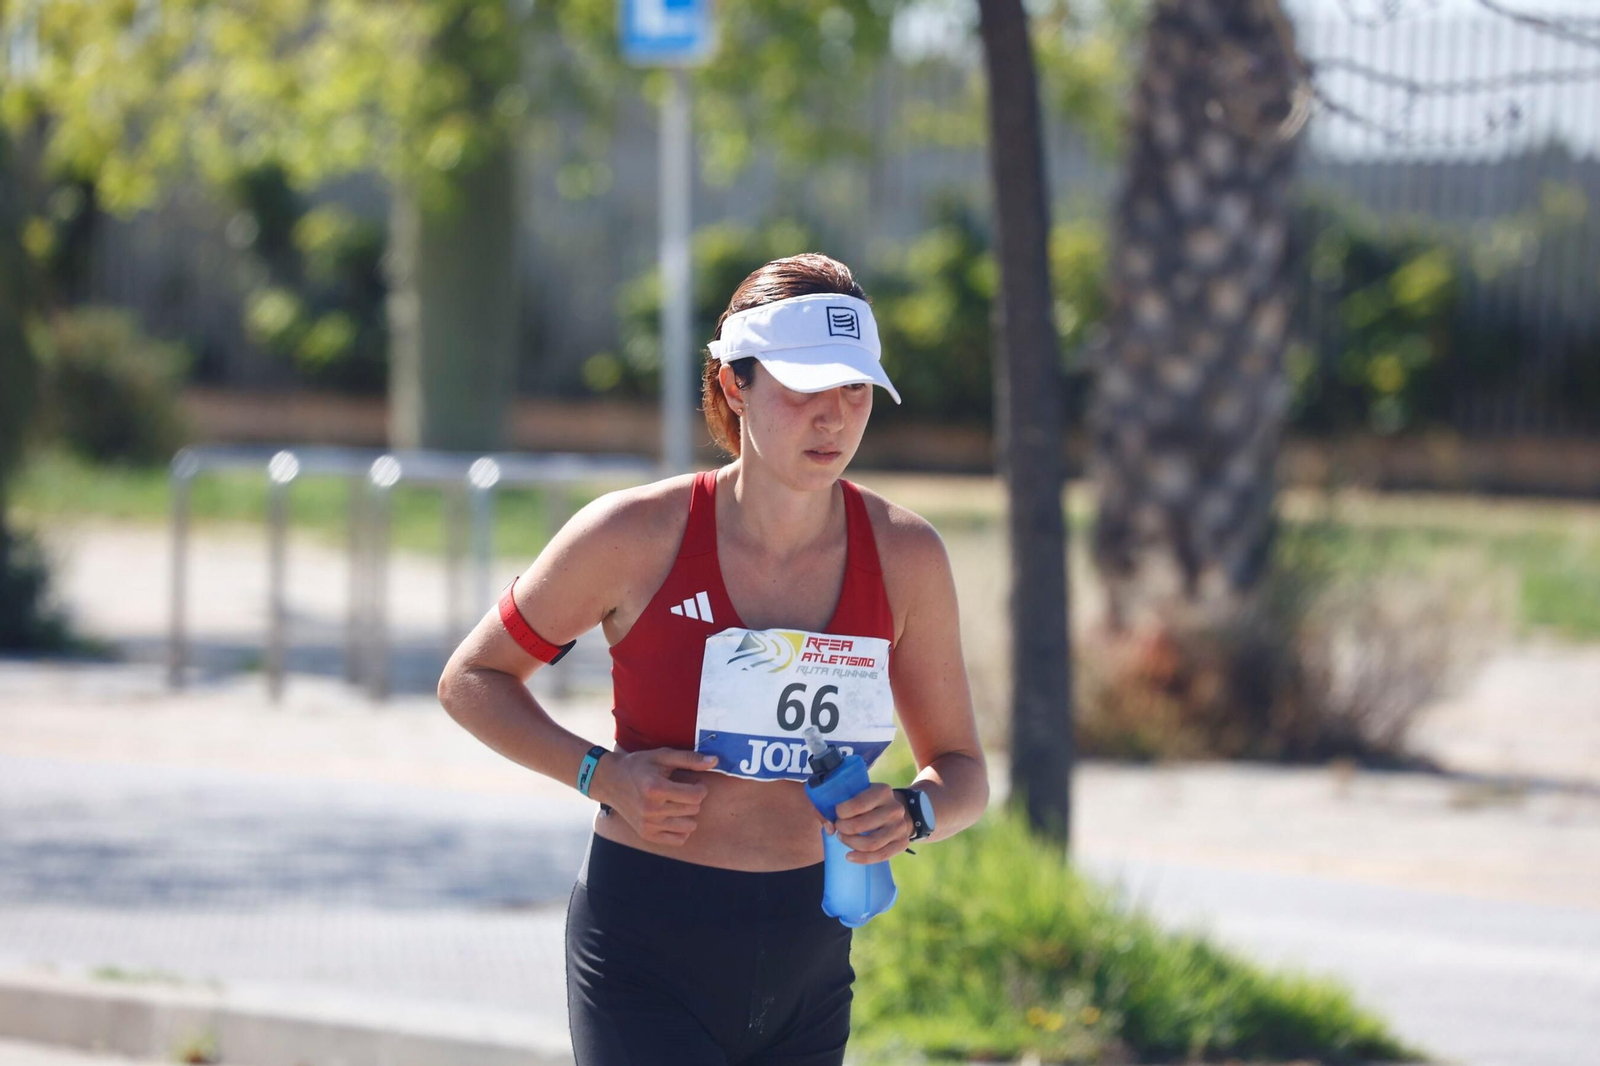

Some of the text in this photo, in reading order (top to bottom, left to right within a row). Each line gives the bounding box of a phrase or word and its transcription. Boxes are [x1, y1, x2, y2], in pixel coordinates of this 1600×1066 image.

[806, 637, 853, 652] RFEA
[801, 652, 875, 668] ATLETISMO
[796, 665, 878, 679] RUTA RUNNING
[776, 682, 840, 734] 66
